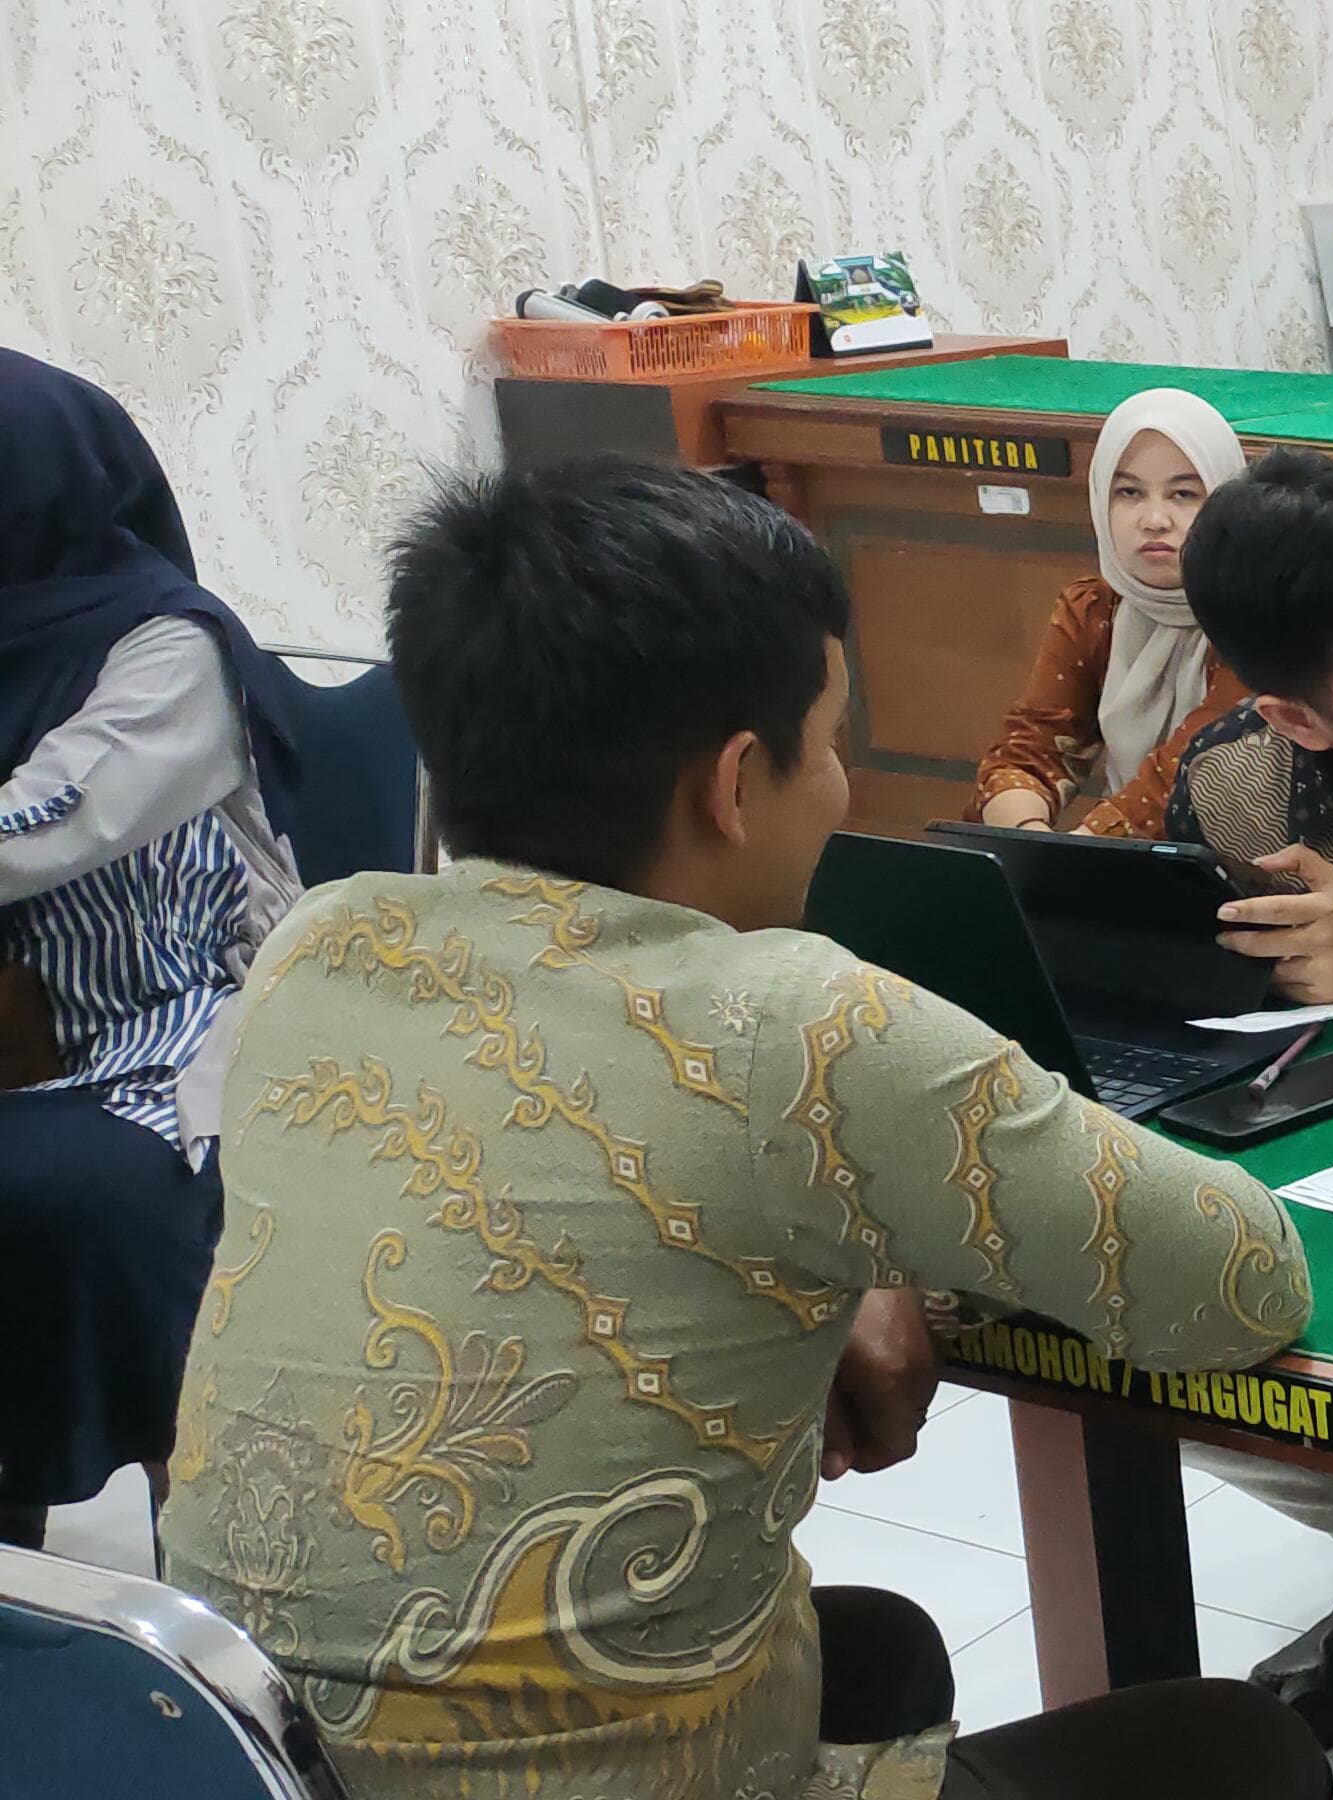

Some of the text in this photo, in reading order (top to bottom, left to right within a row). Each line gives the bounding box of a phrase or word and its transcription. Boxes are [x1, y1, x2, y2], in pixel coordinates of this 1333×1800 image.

[908, 433, 1038, 470] PANITERA
[950, 1320, 1112, 1394] RMOHON
[1150, 1369, 1332, 1441] TERGUGAT
